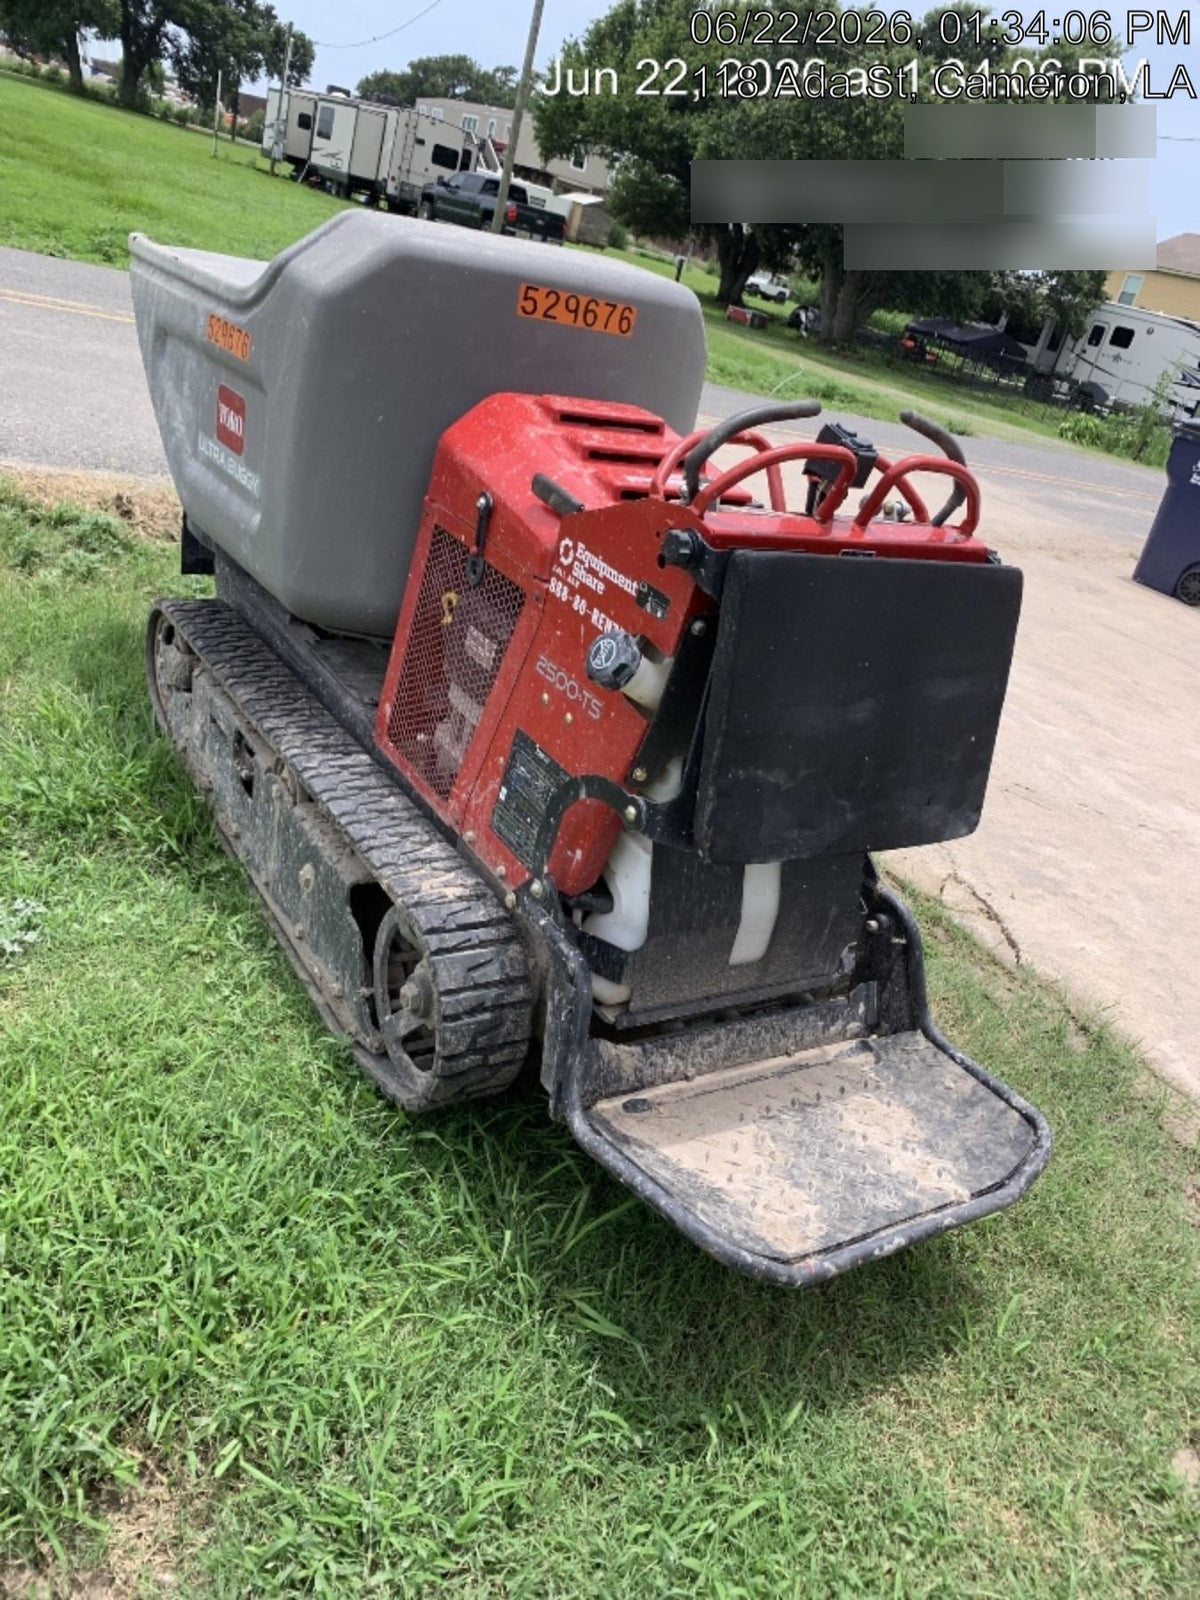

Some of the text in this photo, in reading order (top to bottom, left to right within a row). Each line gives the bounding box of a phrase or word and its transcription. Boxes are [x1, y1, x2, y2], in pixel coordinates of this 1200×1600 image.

[520, 286, 633, 334] 529676
[208, 314, 250, 359] 529676
[572, 561, 605, 594] Share
[576, 542, 639, 597] Equipment
